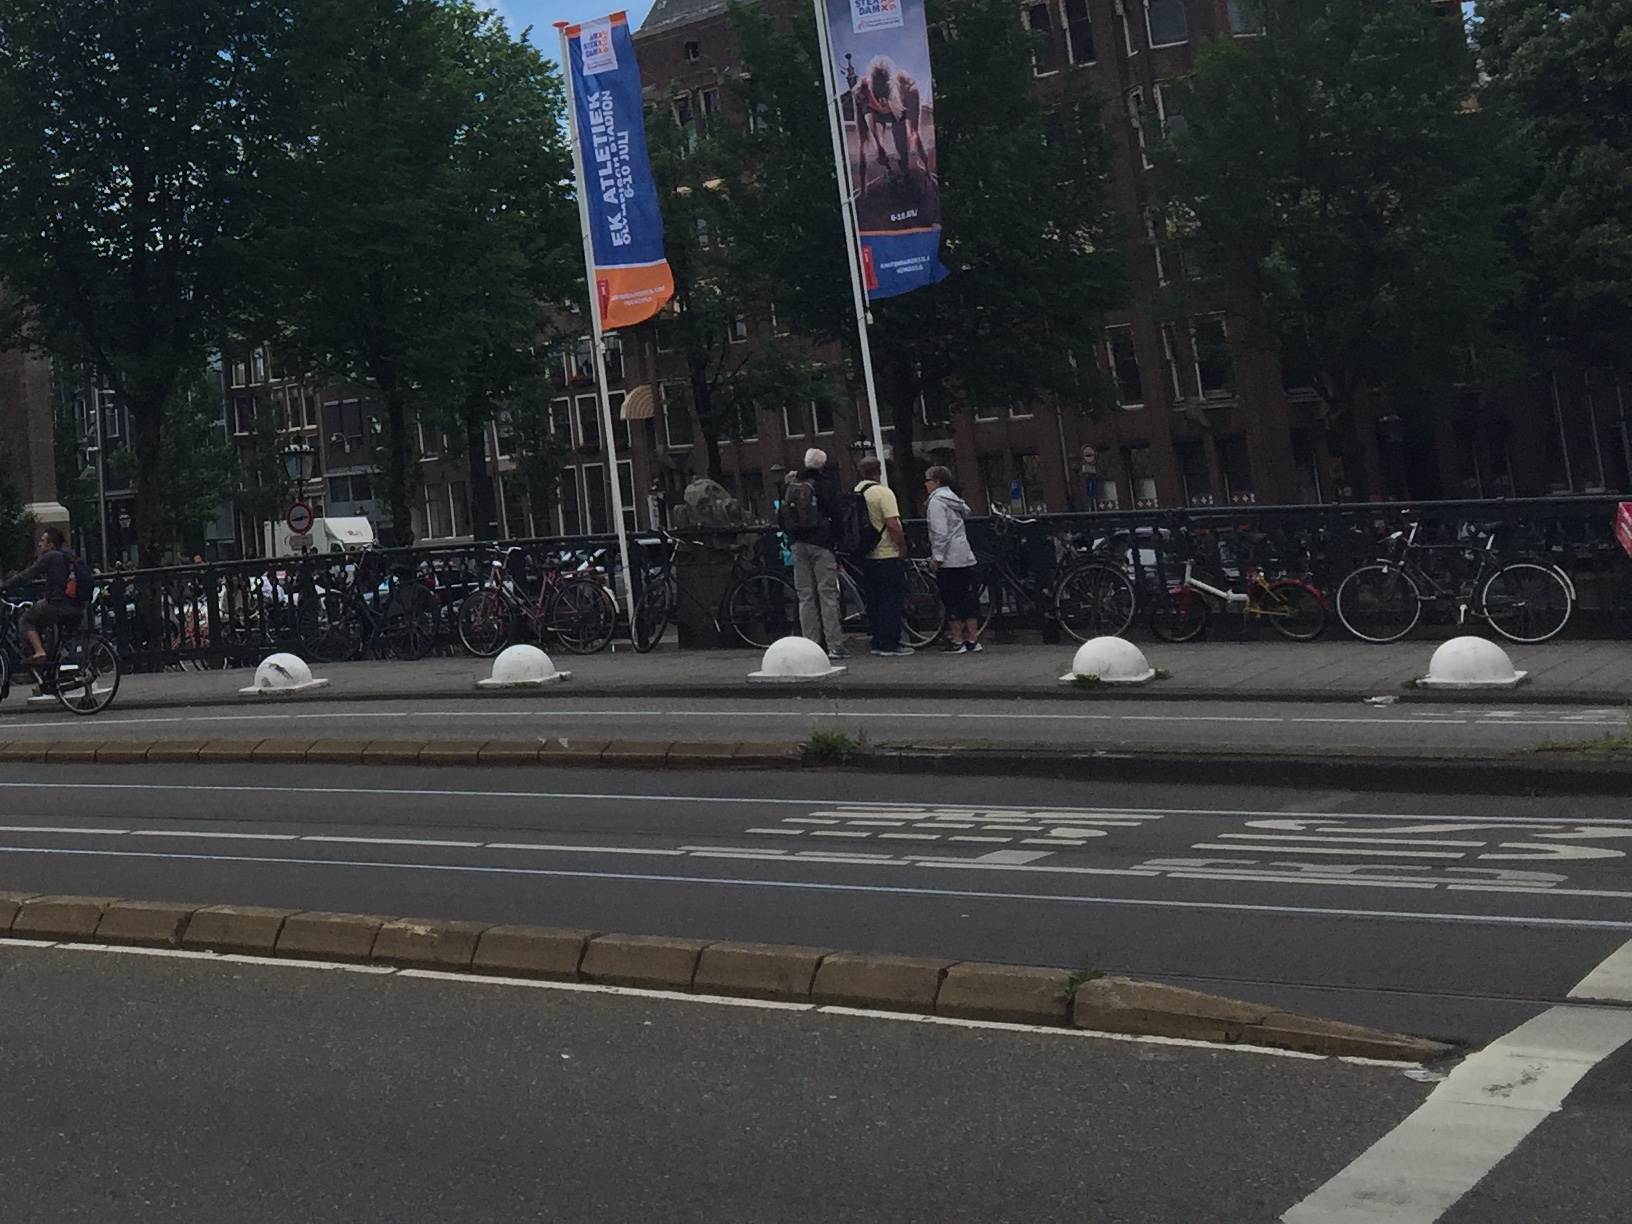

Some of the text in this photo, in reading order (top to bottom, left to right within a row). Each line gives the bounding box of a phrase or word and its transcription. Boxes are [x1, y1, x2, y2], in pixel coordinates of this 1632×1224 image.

[859, 5, 881, 16] DAM
[587, 91, 617, 203] ATLETIEK
[601, 89, 618, 155] STADION
[615, 131, 635, 200] 6-10 JULI
[608, 210, 625, 247] EK
[1127, 819, 1632, 888] BUS
